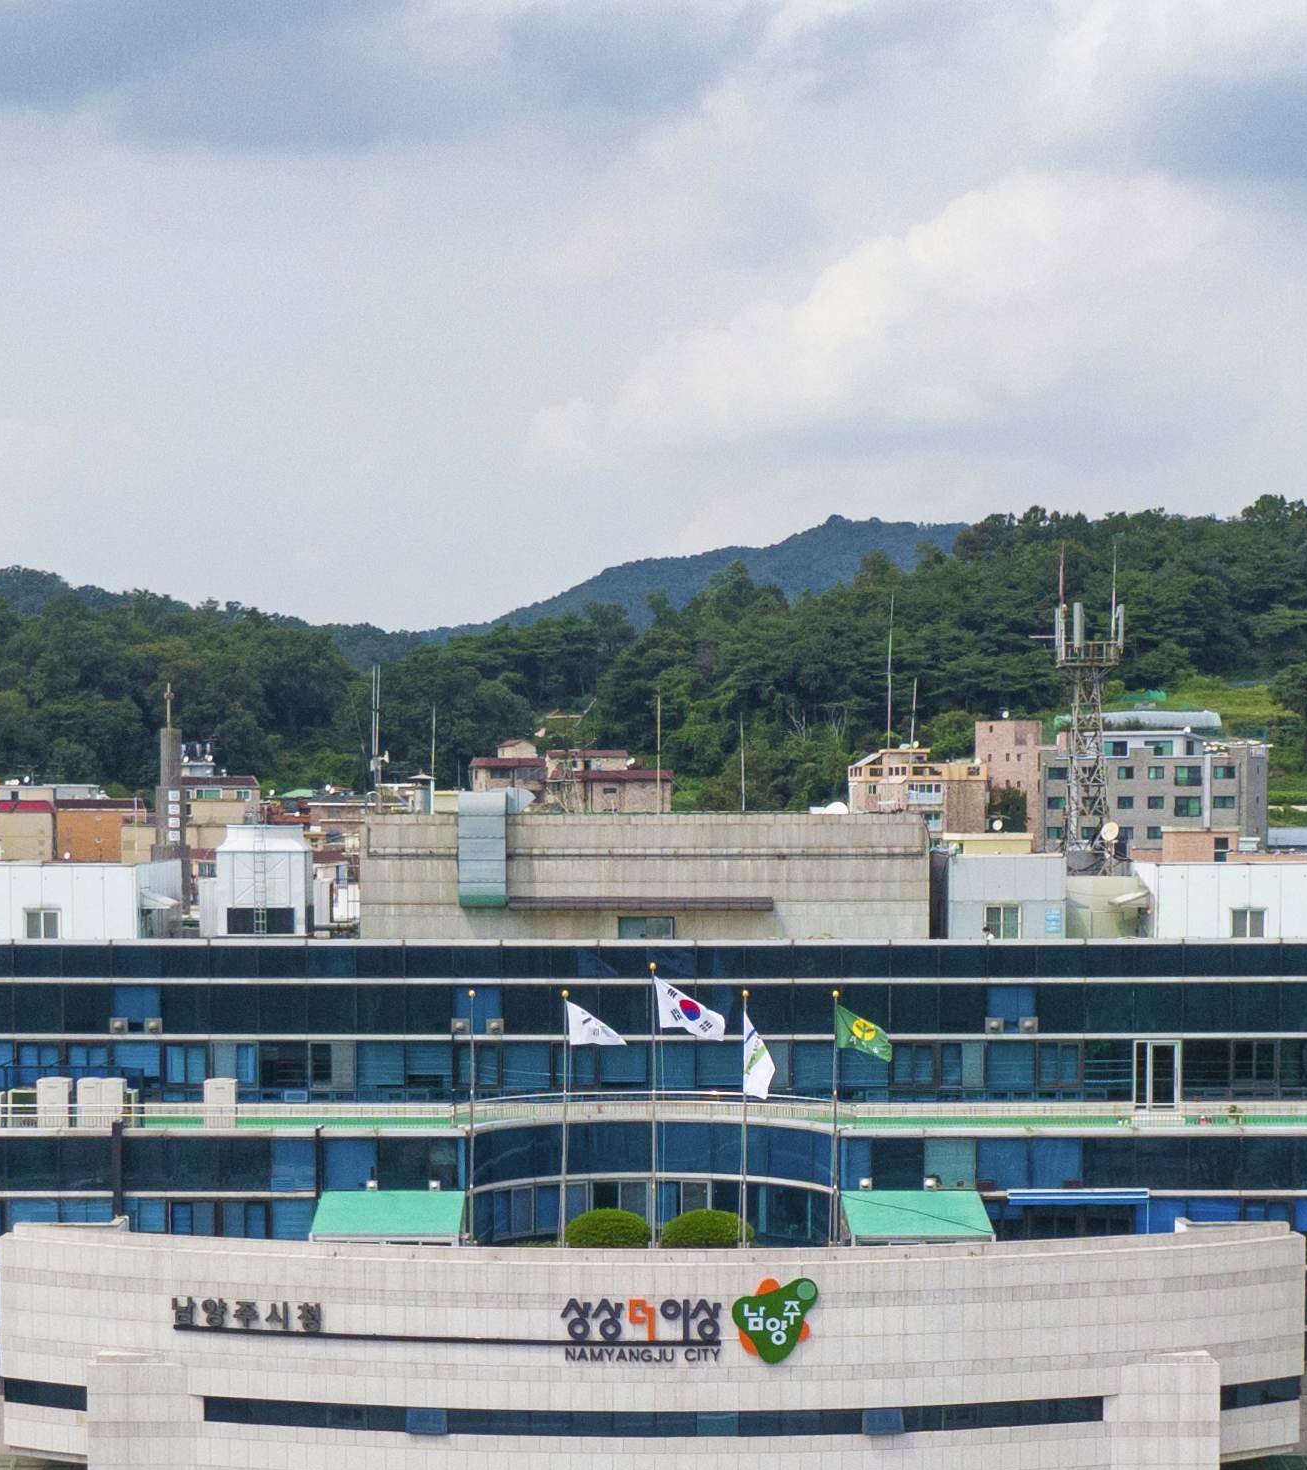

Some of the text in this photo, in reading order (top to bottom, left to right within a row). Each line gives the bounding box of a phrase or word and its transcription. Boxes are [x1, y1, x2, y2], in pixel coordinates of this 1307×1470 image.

[171, 1297, 322, 1332] 남양주시청
[743, 1301, 801, 1345] 남양주
[564, 1347, 721, 1362] NAMYANGJU CITY
